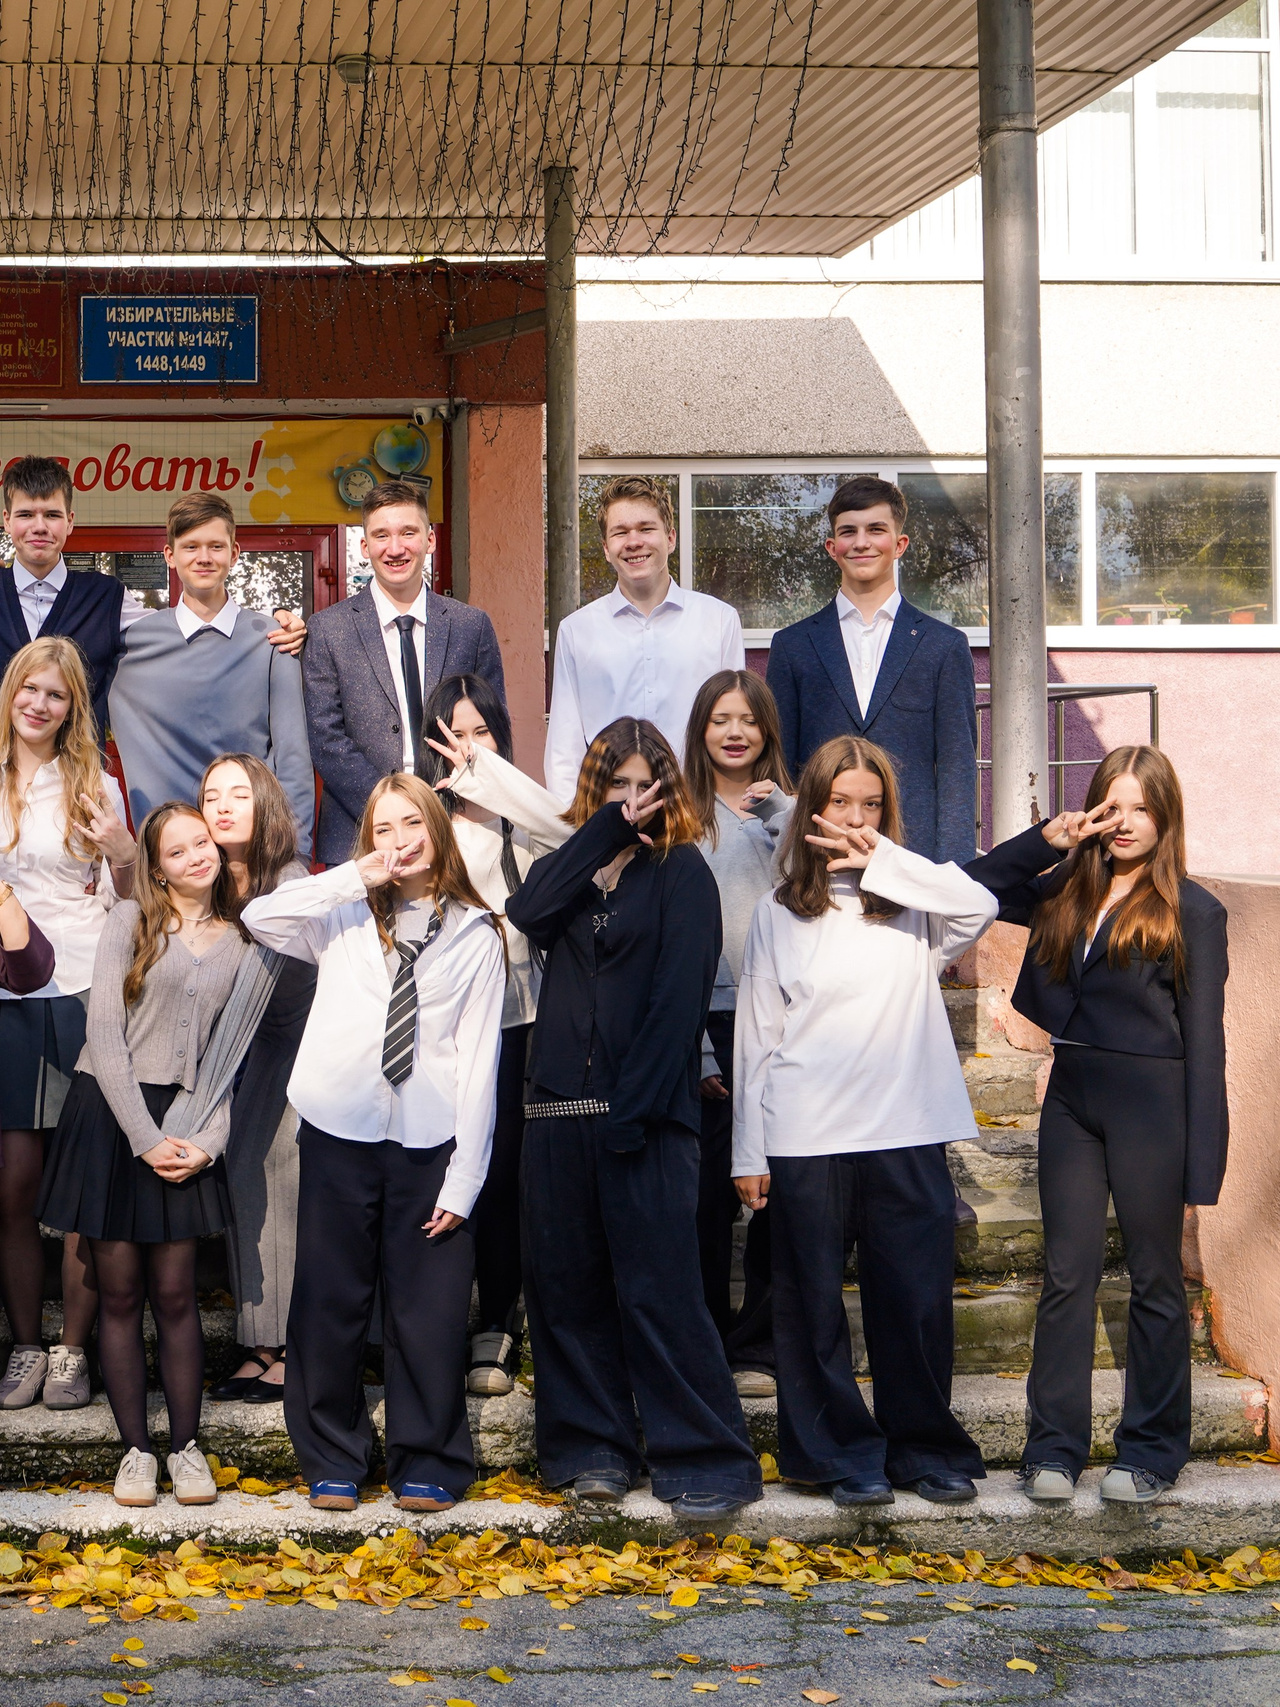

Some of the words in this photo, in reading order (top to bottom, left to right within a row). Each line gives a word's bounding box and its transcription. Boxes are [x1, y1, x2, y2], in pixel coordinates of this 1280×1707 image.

[106, 306, 235, 323] ИЗБИРАТЕЛЬНЫЕ
[17, 337, 58, 357] №45
[107, 331, 174, 347] УЧАСТКИ
[178, 331, 233, 351] №1447,
[135, 354, 206, 375] 1448,1449
